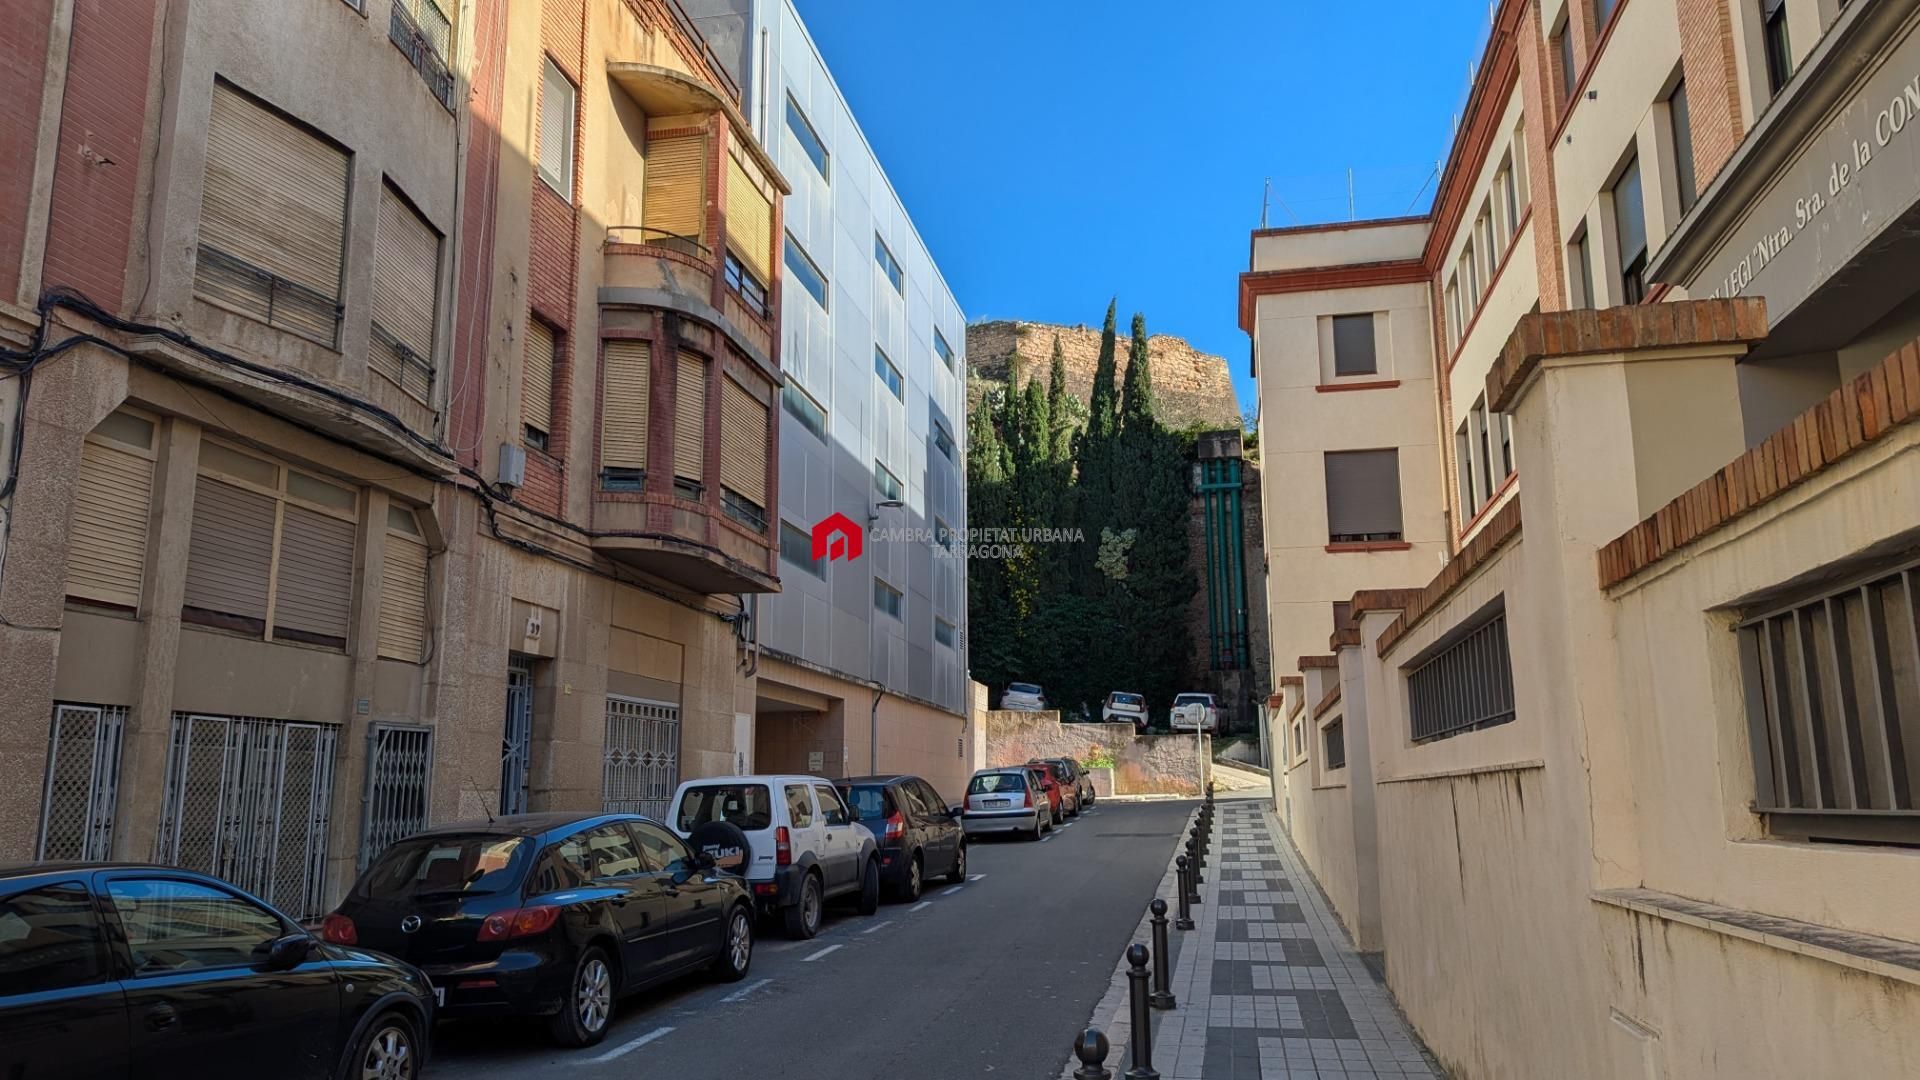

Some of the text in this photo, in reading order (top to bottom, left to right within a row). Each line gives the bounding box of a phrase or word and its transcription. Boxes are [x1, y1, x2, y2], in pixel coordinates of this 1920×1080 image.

[1795, 192, 1826, 230] Sra.
[1829, 162, 1850, 196] de
[1852, 139, 1872, 172] la
